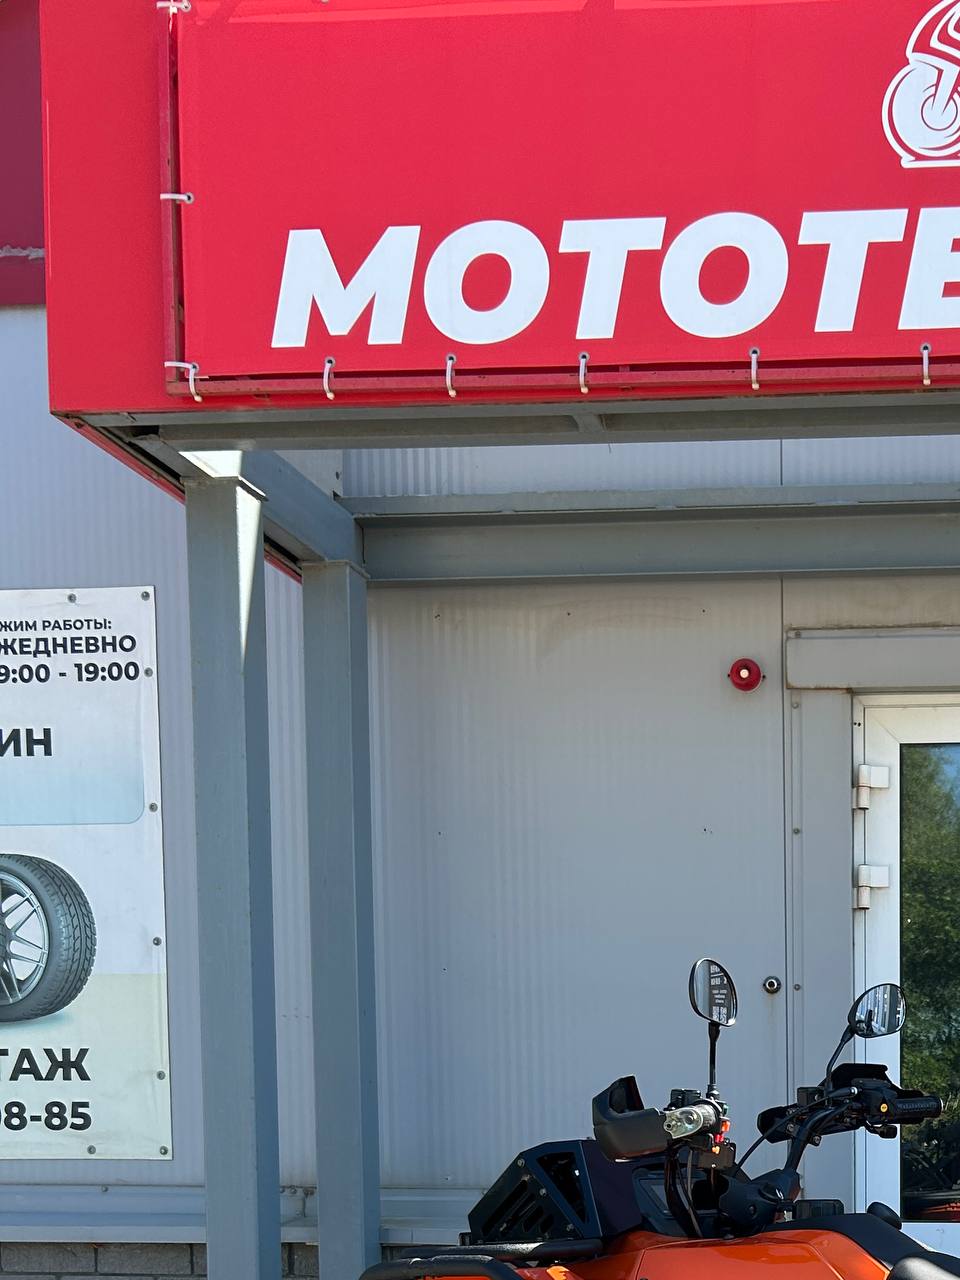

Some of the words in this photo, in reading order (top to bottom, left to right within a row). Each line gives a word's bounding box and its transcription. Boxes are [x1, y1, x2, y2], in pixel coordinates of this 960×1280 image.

[42, 618, 112, 631] РАБОТЫ:
[0, 635, 137, 658] ЖЕДНЕВНО
[74, 661, 140, 682] 19:00
[0, 727, 53, 757] ИН
[0, 1100, 92, 1132] 8-85
